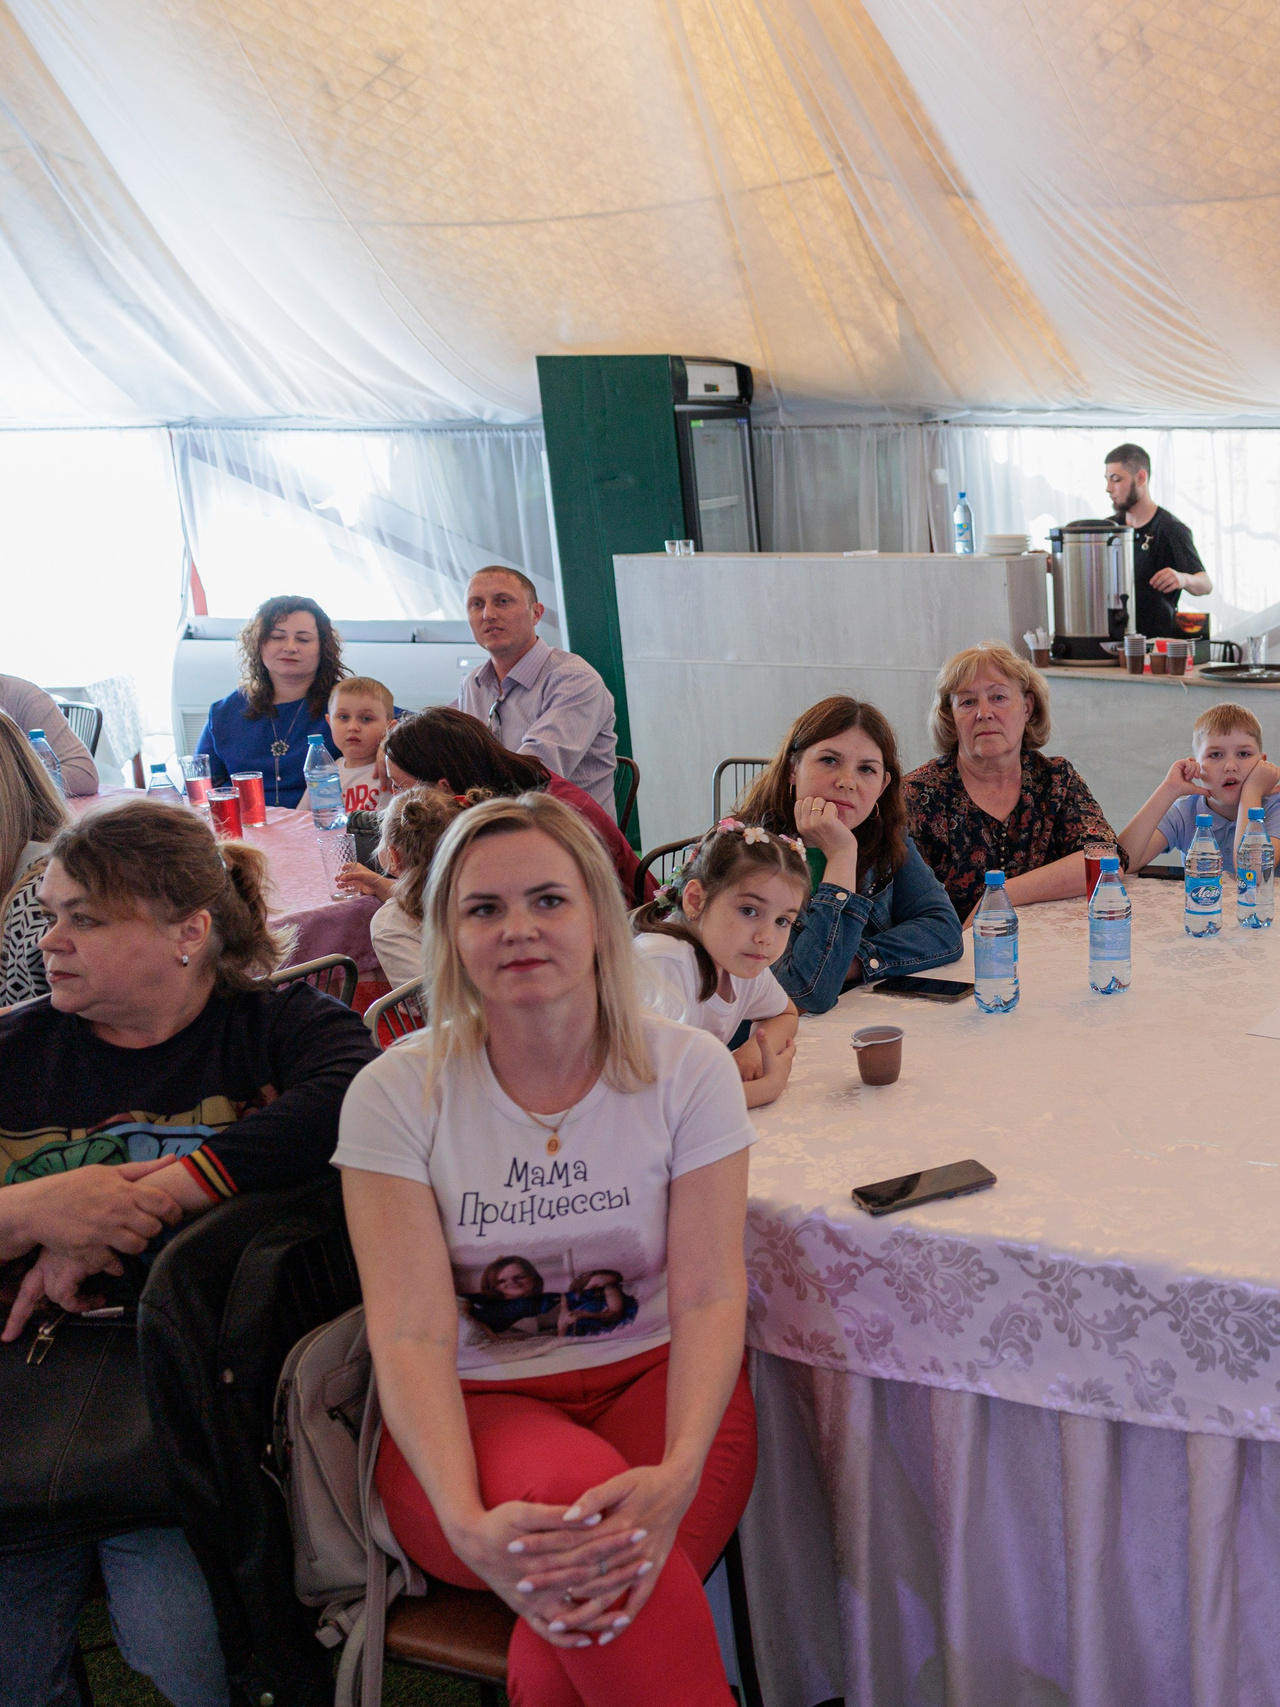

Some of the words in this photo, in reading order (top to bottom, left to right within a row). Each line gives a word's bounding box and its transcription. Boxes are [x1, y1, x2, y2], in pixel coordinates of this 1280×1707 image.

[343, 784, 379, 812] ARS
[503, 1157, 588, 1193] Мама
[458, 1187, 631, 1237] Принцессы
